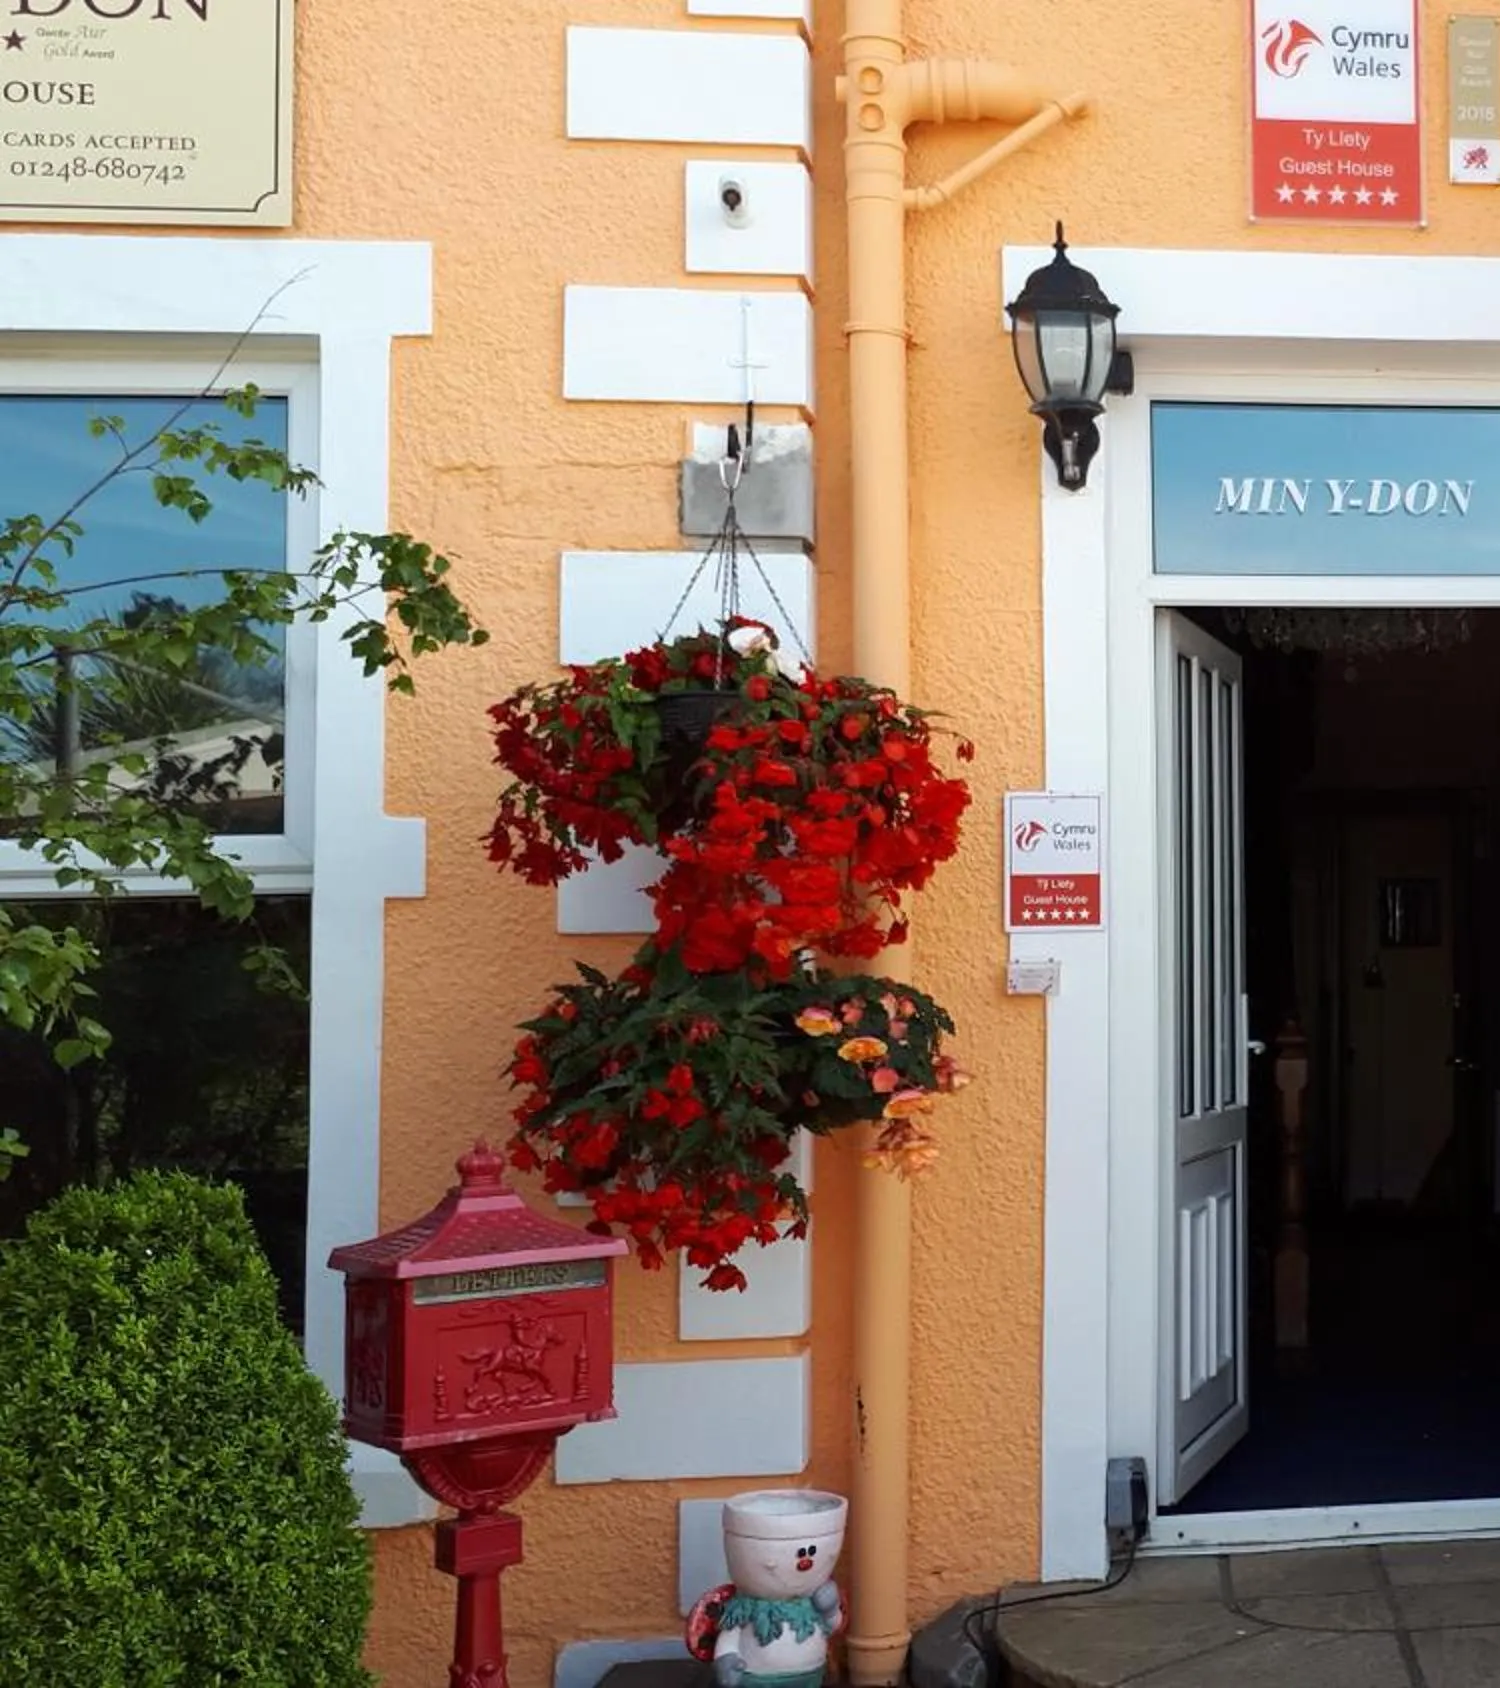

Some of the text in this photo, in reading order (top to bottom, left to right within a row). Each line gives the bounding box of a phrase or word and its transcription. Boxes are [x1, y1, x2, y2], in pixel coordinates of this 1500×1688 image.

[1331, 25, 1409, 52] Cymru
[1333, 57, 1401, 78] Wales
[3, 81, 96, 105] OUSE
[3, 132, 196, 151] CARDS ACCEPTED
[1328, 130, 1371, 152] Llety
[10, 157, 186, 186] 01248-680742
[1279, 157, 1394, 177] Guest House
[1215, 477, 1475, 516] MIN Y-DON
[1052, 823, 1096, 837] Cymru
[1053, 840, 1091, 851] Wales
[1023, 894, 1089, 905] Guest House
